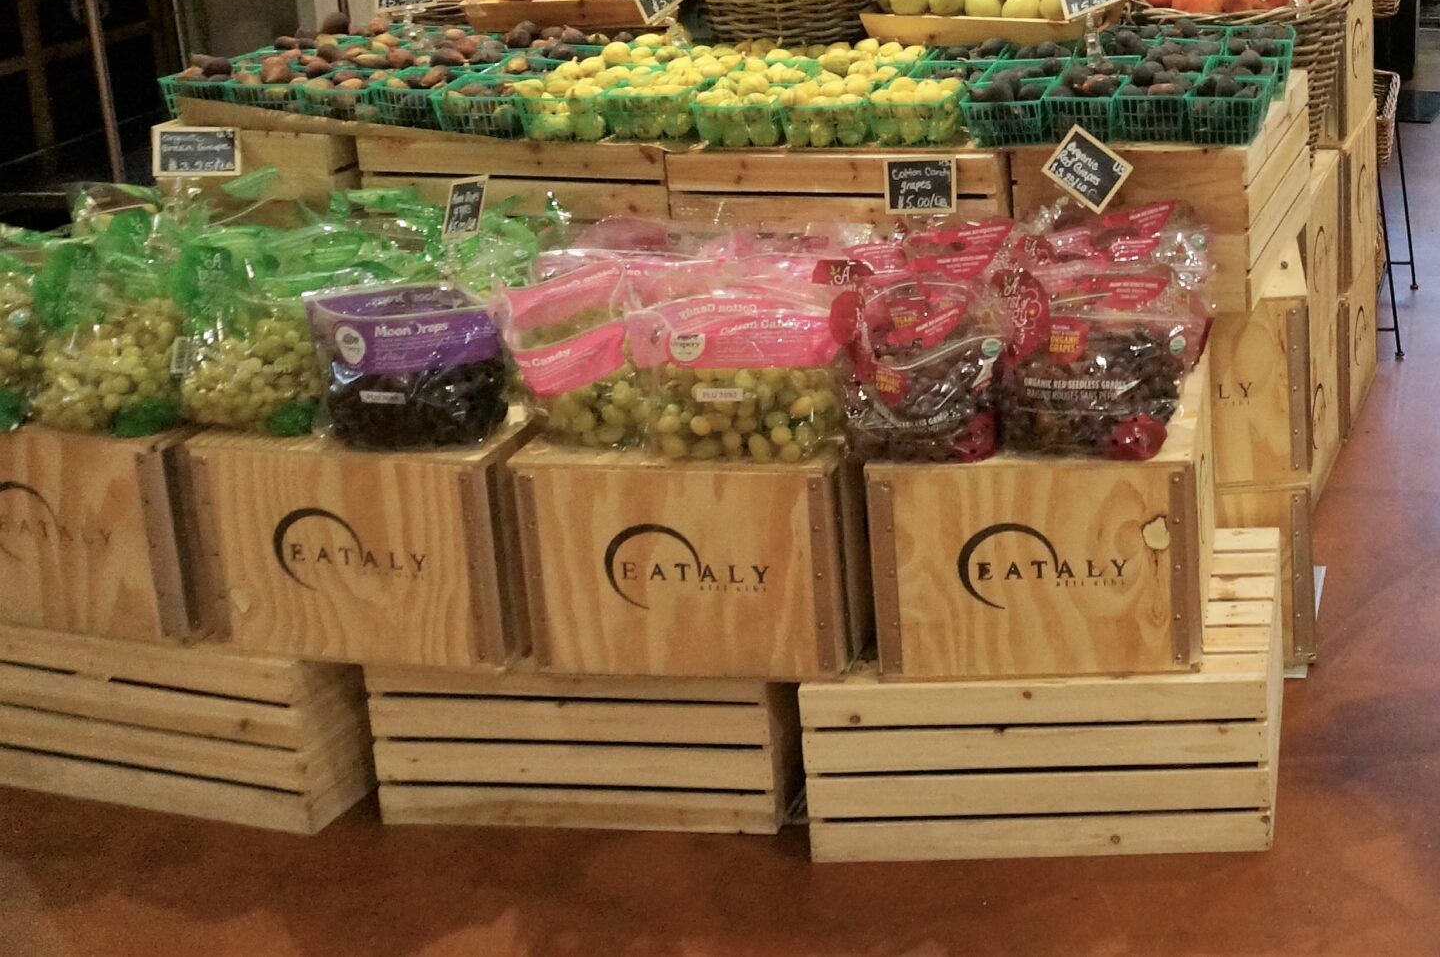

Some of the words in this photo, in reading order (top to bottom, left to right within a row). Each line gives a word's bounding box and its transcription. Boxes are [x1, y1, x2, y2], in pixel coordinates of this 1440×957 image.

[891, 167, 922, 181] Cotton
[900, 180, 932, 194] grapes
[374, 324, 412, 338] Moon
[531, 347, 572, 367] Candy
[288, 543, 428, 573] EATALY
[621, 561, 770, 585] EATALY
[976, 559, 1128, 581] EATALY
